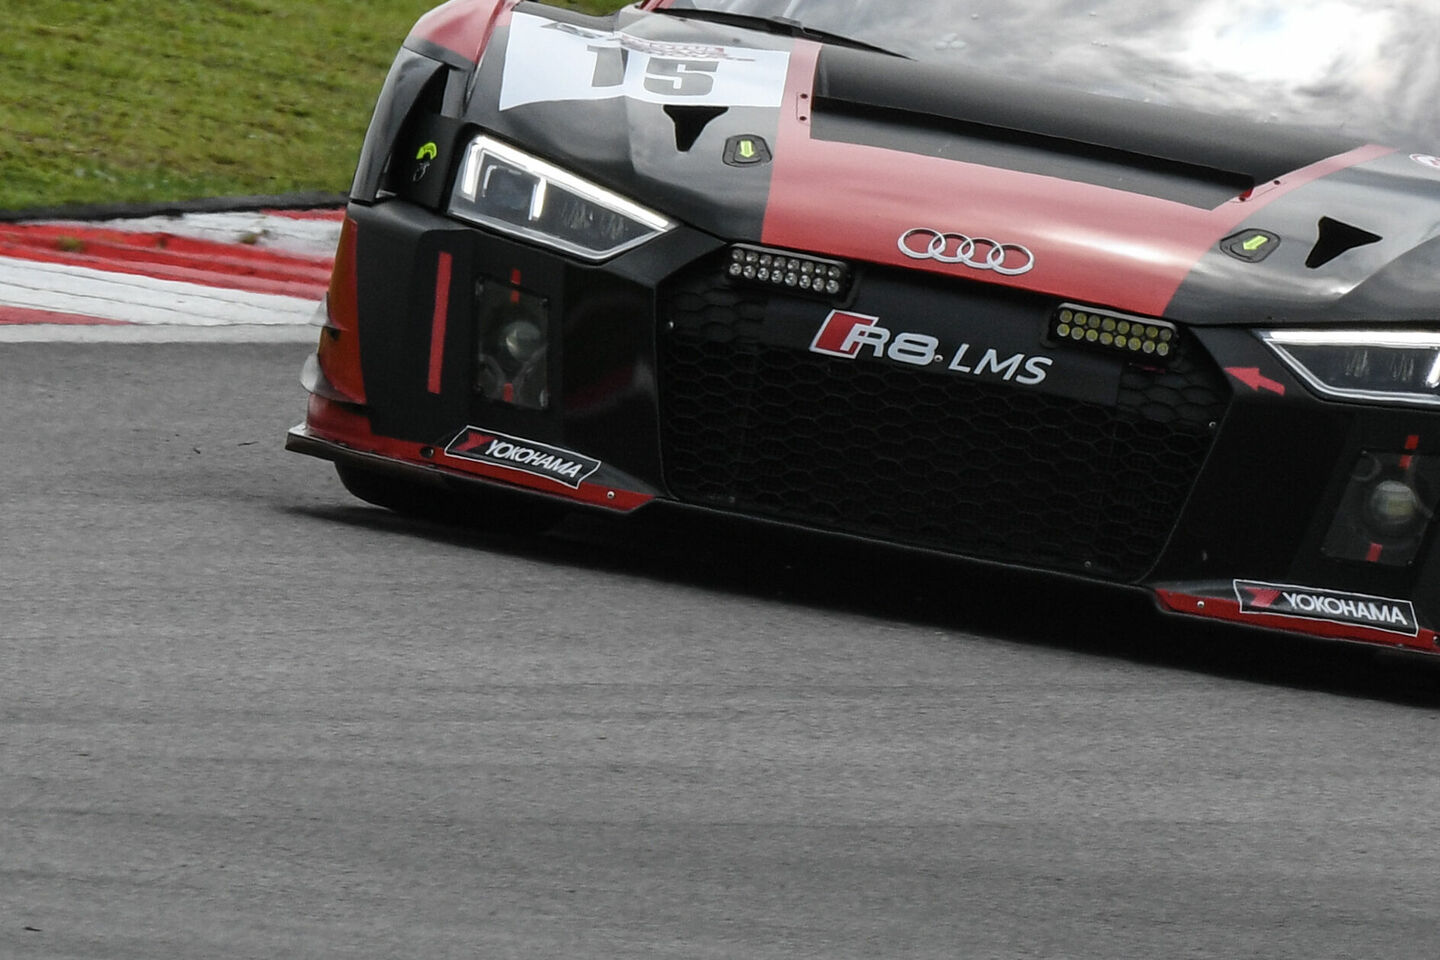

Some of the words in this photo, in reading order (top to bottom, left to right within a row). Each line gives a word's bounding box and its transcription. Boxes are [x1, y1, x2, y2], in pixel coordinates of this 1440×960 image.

[587, 44, 720, 96] 15
[839, 323, 939, 366] R8
[948, 343, 1053, 385] LMS
[485, 440, 583, 478] YOKOHAMA
[1282, 592, 1408, 626] YOKOHAMA
